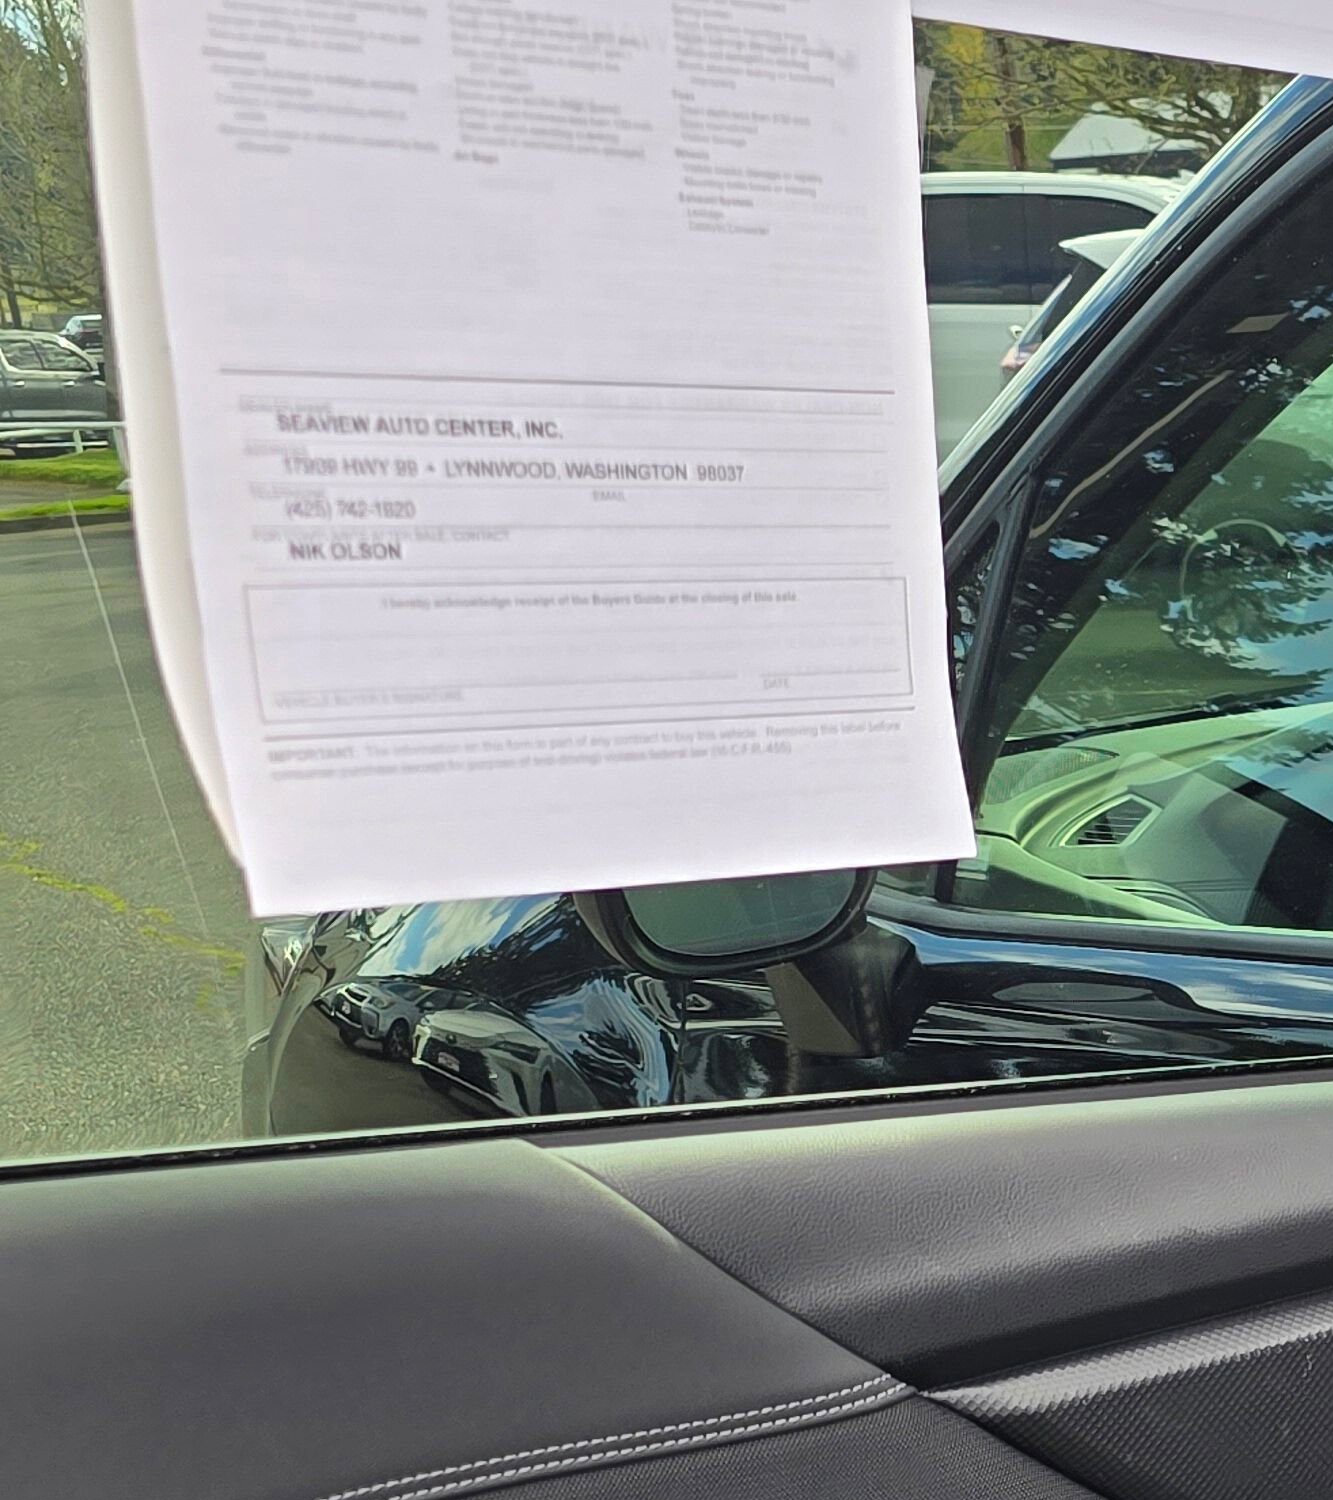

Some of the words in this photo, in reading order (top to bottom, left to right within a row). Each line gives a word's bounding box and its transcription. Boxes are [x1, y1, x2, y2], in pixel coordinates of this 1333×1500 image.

[277, 413, 370, 434] SEAVIEW
[376, 416, 429, 435] AUTO
[435, 418, 521, 439] CENTER,
[525, 420, 563, 439] INC.
[343, 457, 389, 476] HWY
[445, 460, 561, 480] LYNNWOOD,
[565, 461, 688, 481] WASHINGTON
[697, 465, 745, 482] 98037
[289, 542, 326, 561] NIK
[331, 542, 402, 561] OLSON
